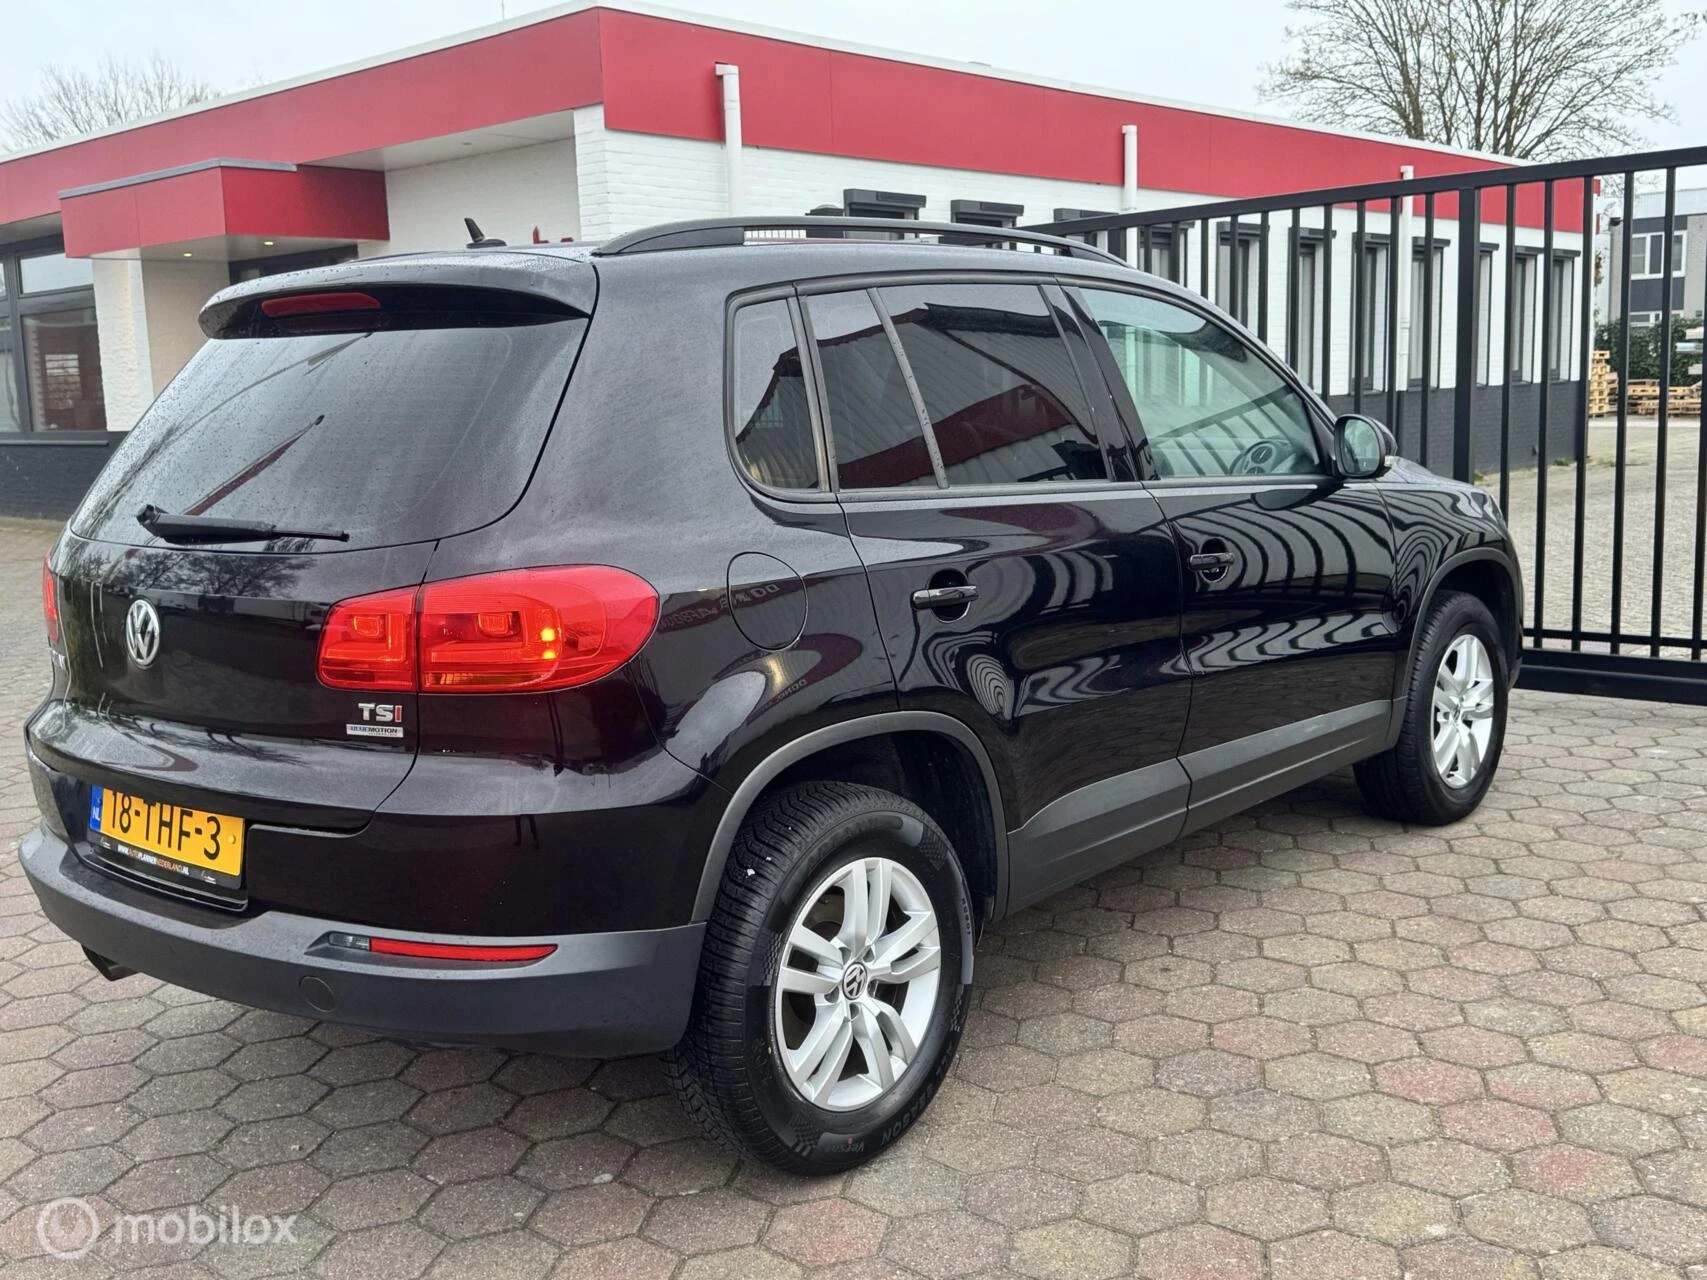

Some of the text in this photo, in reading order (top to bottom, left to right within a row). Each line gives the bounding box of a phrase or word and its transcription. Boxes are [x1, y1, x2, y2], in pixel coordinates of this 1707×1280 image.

[358, 703, 402, 722] TSI
[92, 805, 101, 821] NL
[112, 791, 221, 860] 18-THF-3
